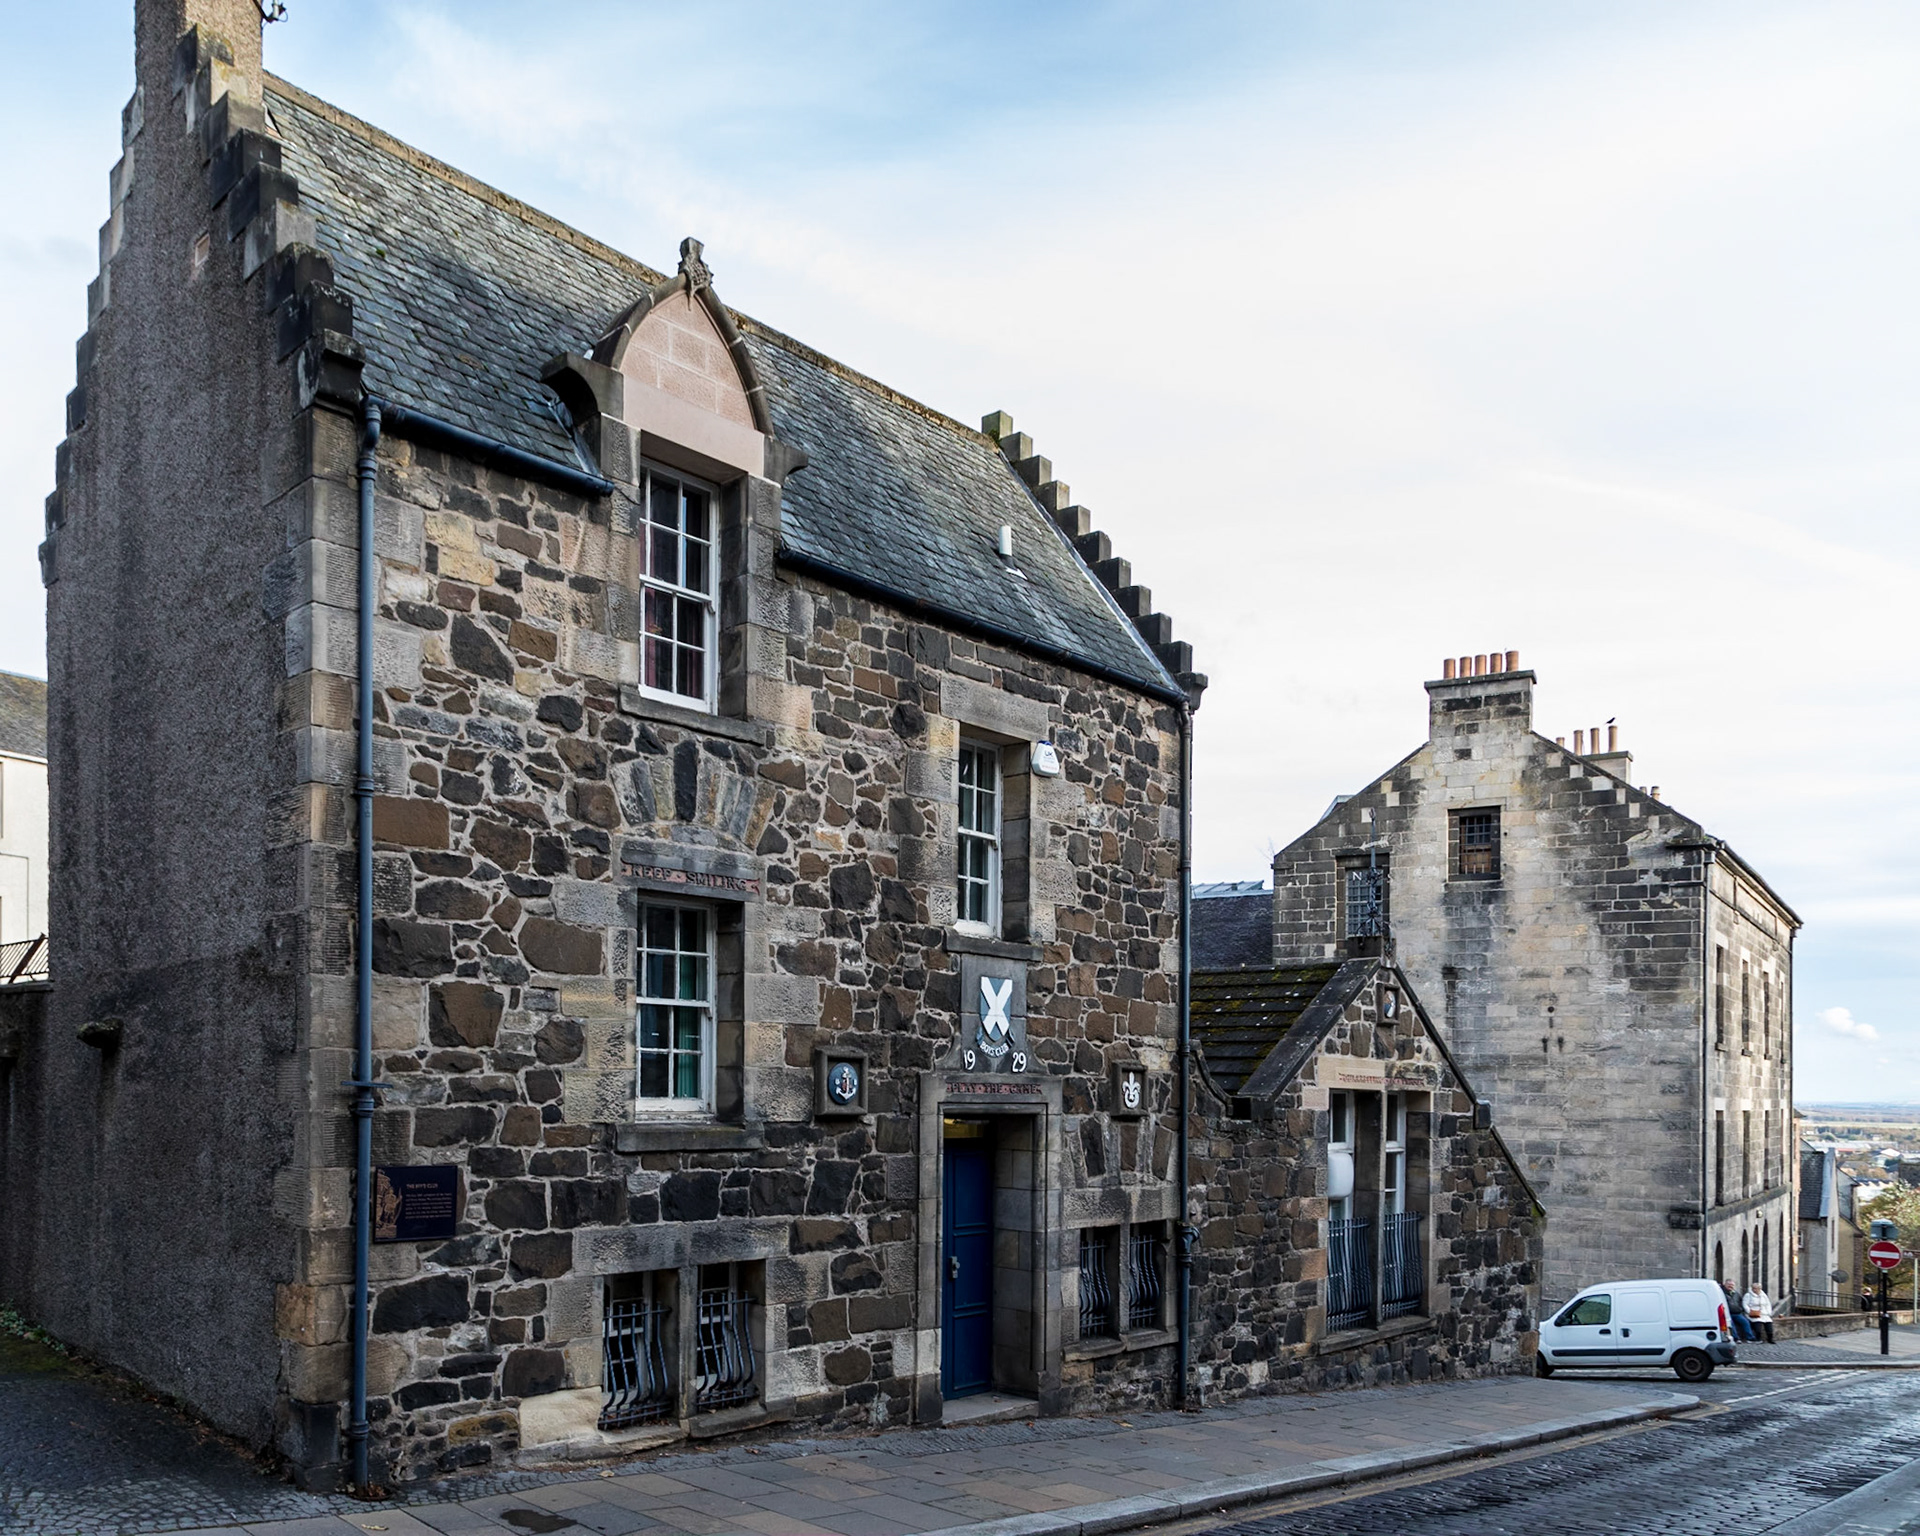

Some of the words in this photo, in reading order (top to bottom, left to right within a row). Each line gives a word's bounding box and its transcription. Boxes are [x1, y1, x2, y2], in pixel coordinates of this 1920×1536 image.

[632, 867, 671, 881] KEEP
[686, 873, 747, 891] SMILING
[1353, 871, 1362, 881] N
[964, 1050, 976, 1070] 19
[1012, 1052, 1027, 1072] 29
